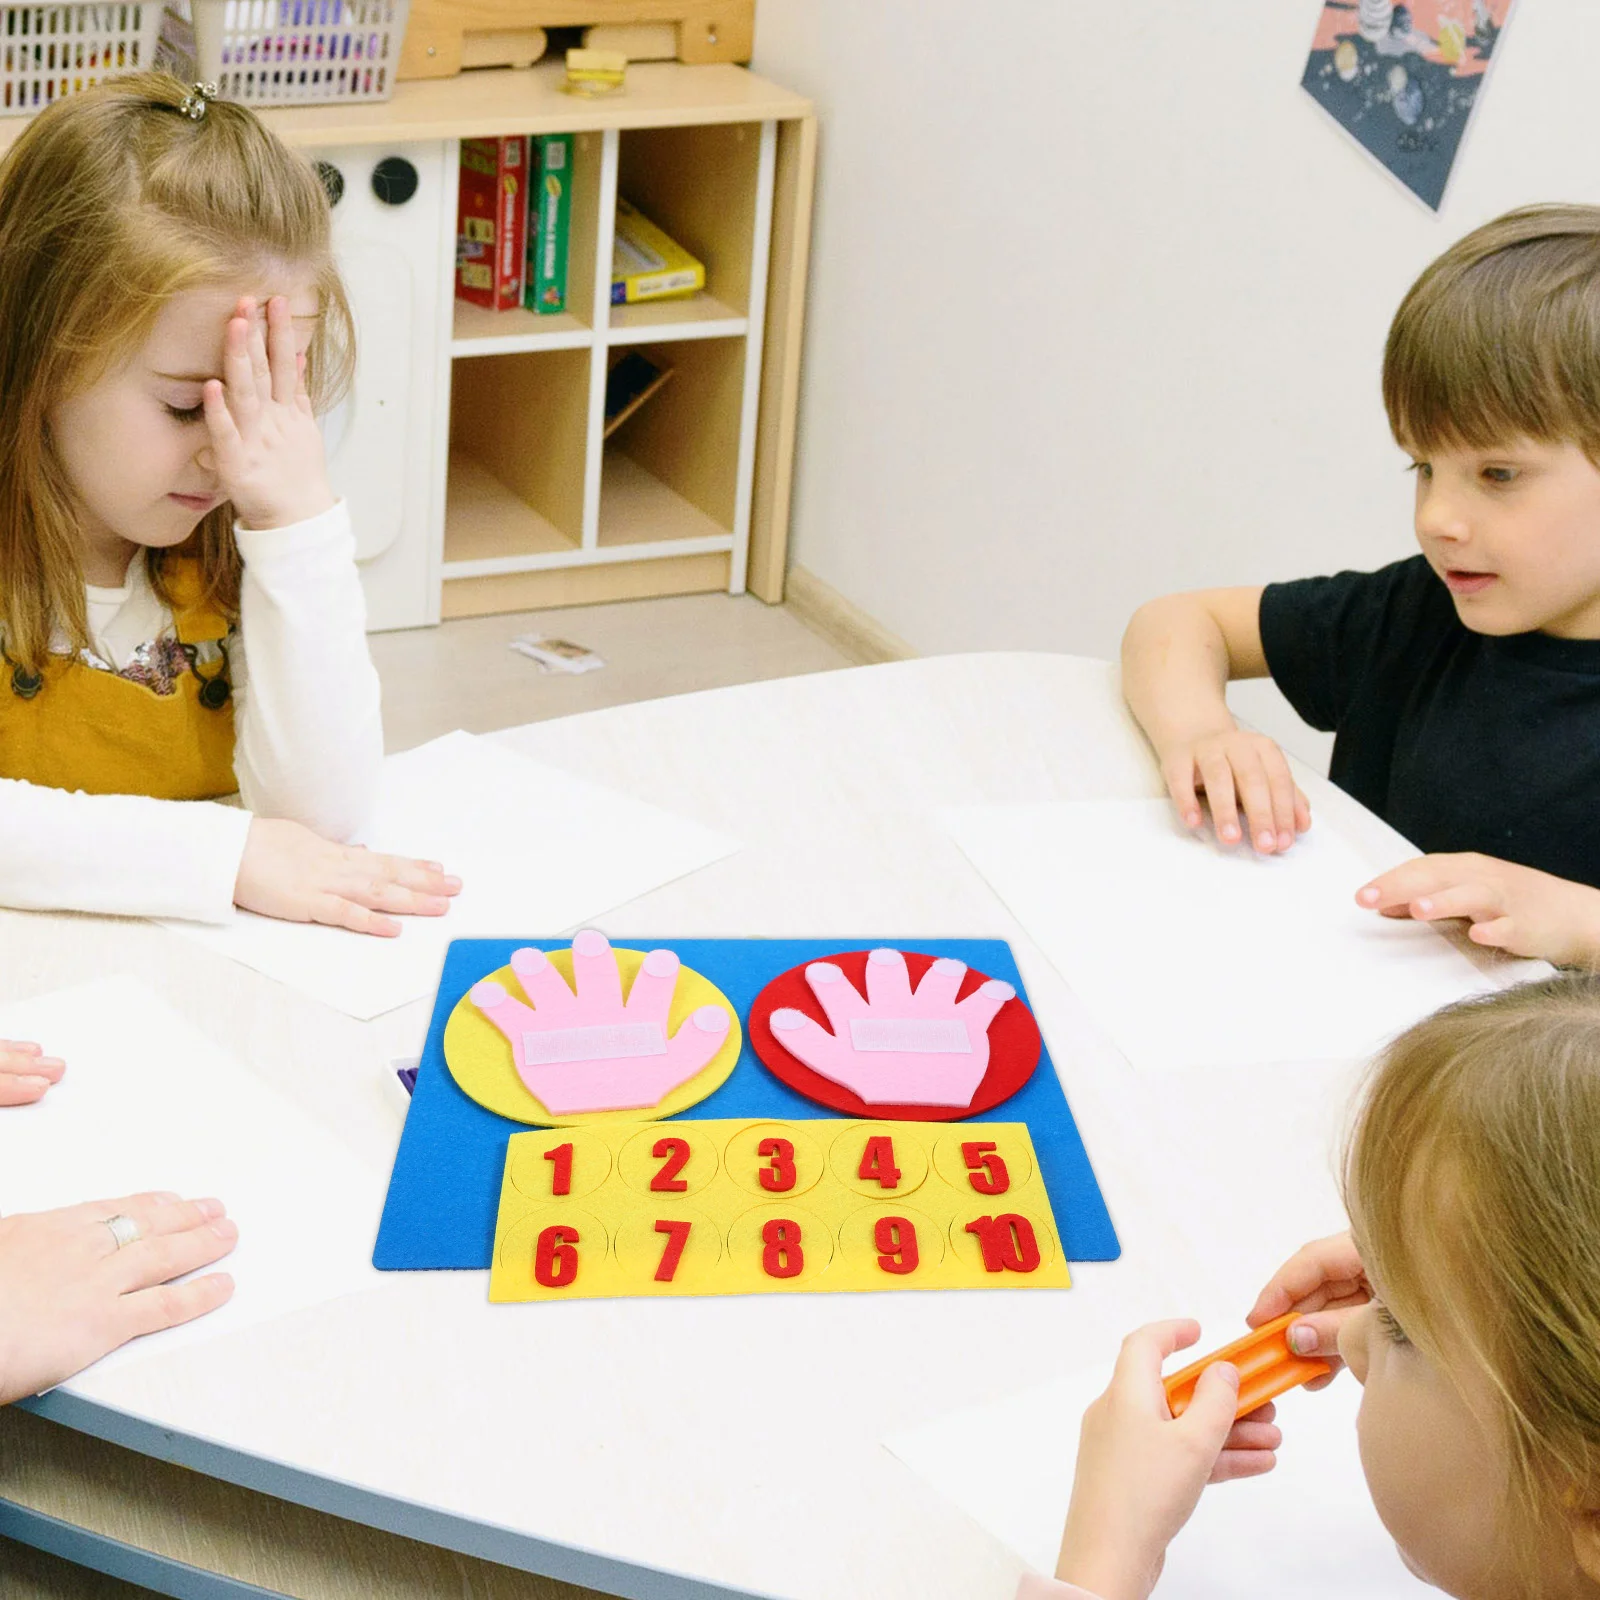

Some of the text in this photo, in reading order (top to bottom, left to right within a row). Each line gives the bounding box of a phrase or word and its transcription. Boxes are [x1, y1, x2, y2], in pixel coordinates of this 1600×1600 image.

[543, 1136, 1010, 1196] 1 2 3 4 5
[534, 1213, 1041, 1288] 6 7 8 9 10
